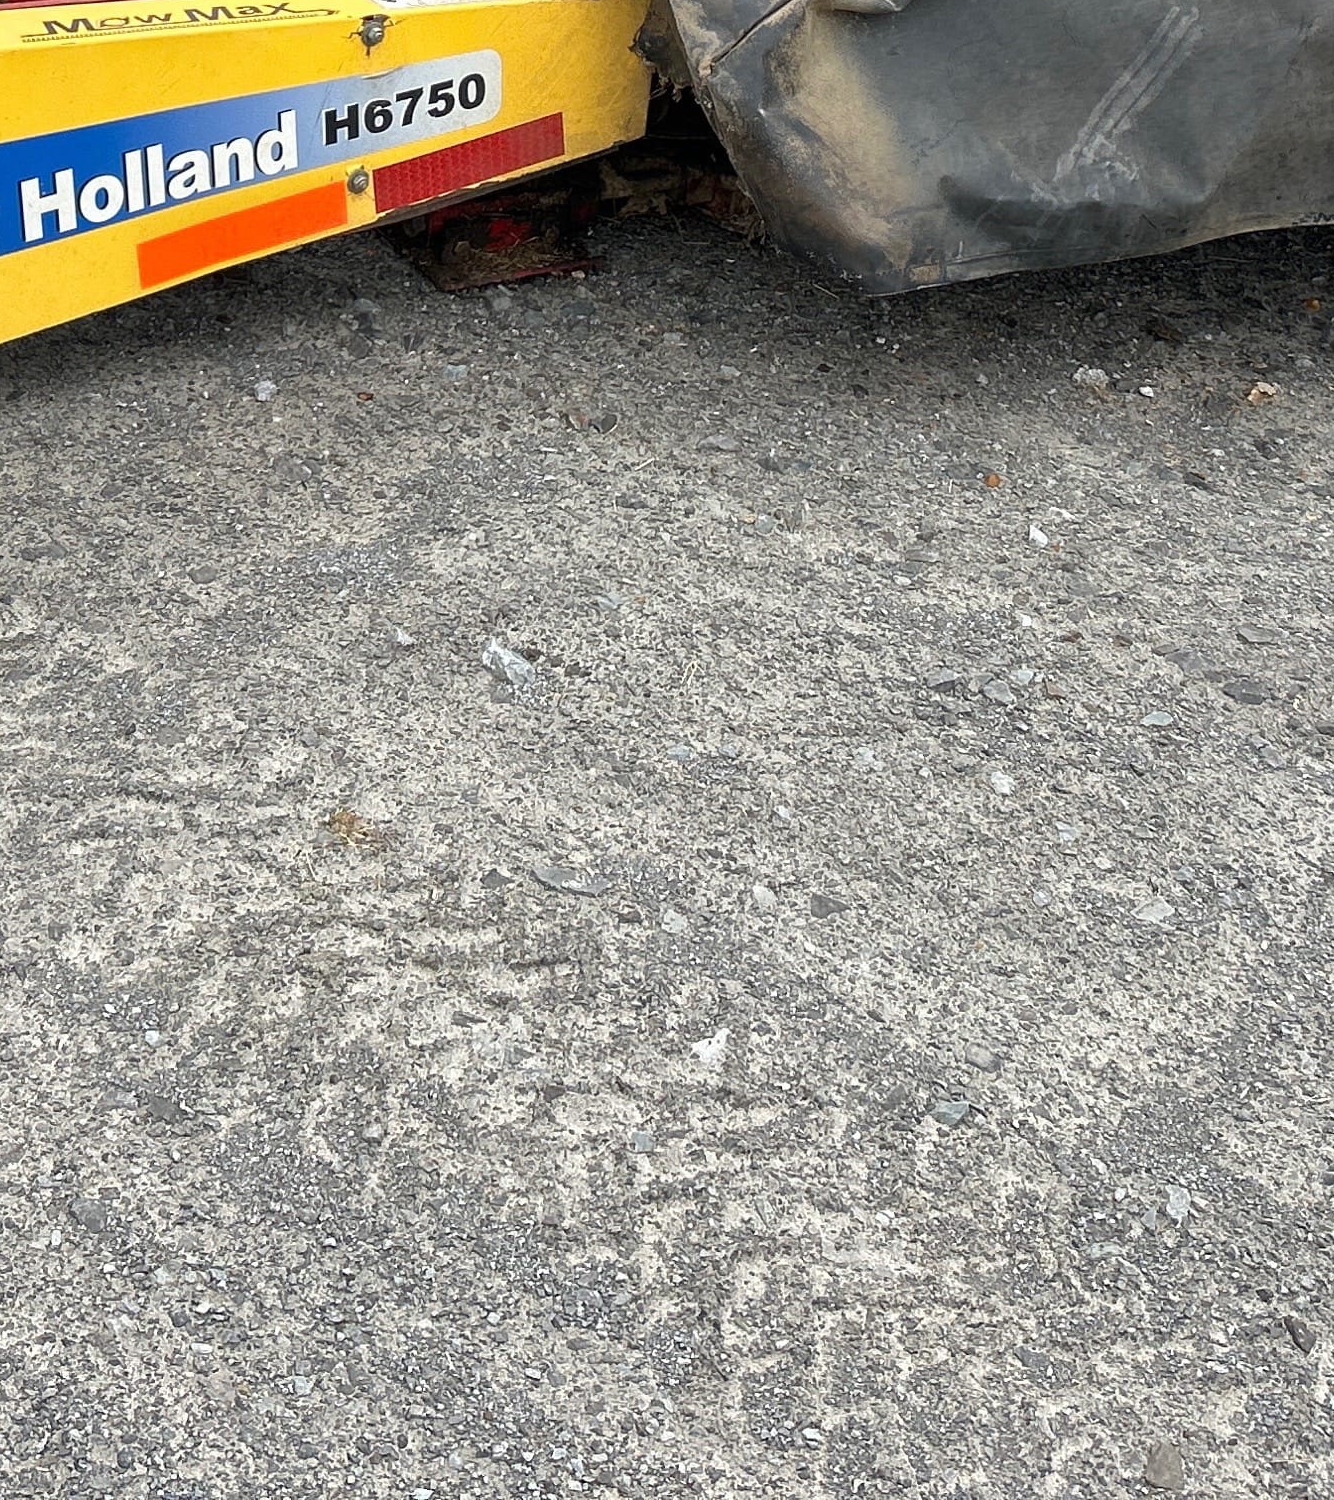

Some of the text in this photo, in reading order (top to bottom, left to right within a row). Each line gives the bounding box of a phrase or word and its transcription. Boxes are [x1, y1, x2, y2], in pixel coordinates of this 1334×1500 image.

[43, 2, 290, 33] Mow Max
[19, 109, 299, 243] Holland
[323, 72, 486, 145] H6750
